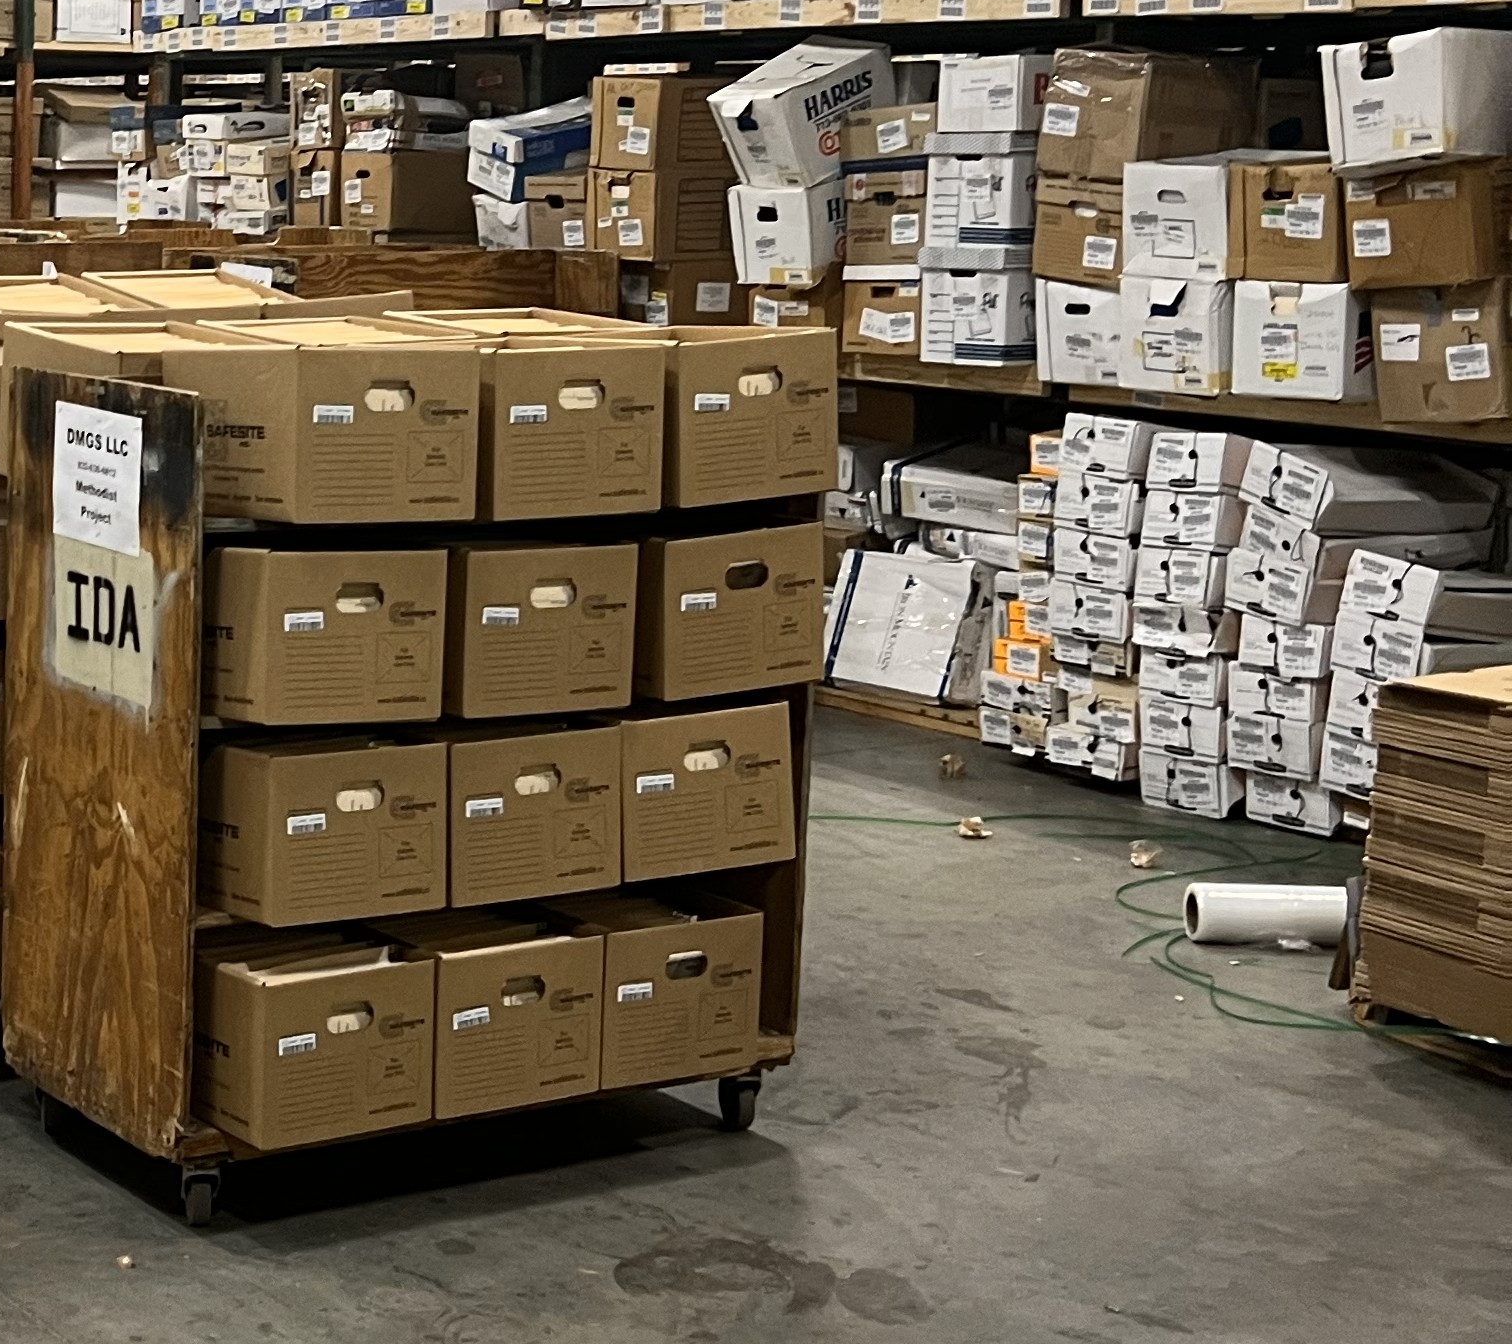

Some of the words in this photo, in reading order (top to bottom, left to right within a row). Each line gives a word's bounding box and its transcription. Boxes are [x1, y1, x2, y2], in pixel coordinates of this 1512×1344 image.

[803, 69, 873, 123] HARRIS
[67, 428, 102, 451] DMGS
[106, 436, 128, 457] LLC
[206, 424, 266, 441] SAFESITE
[75, 480, 118, 502] Methodist
[80, 505, 112, 525] Project
[67, 570, 140, 653] IDA
